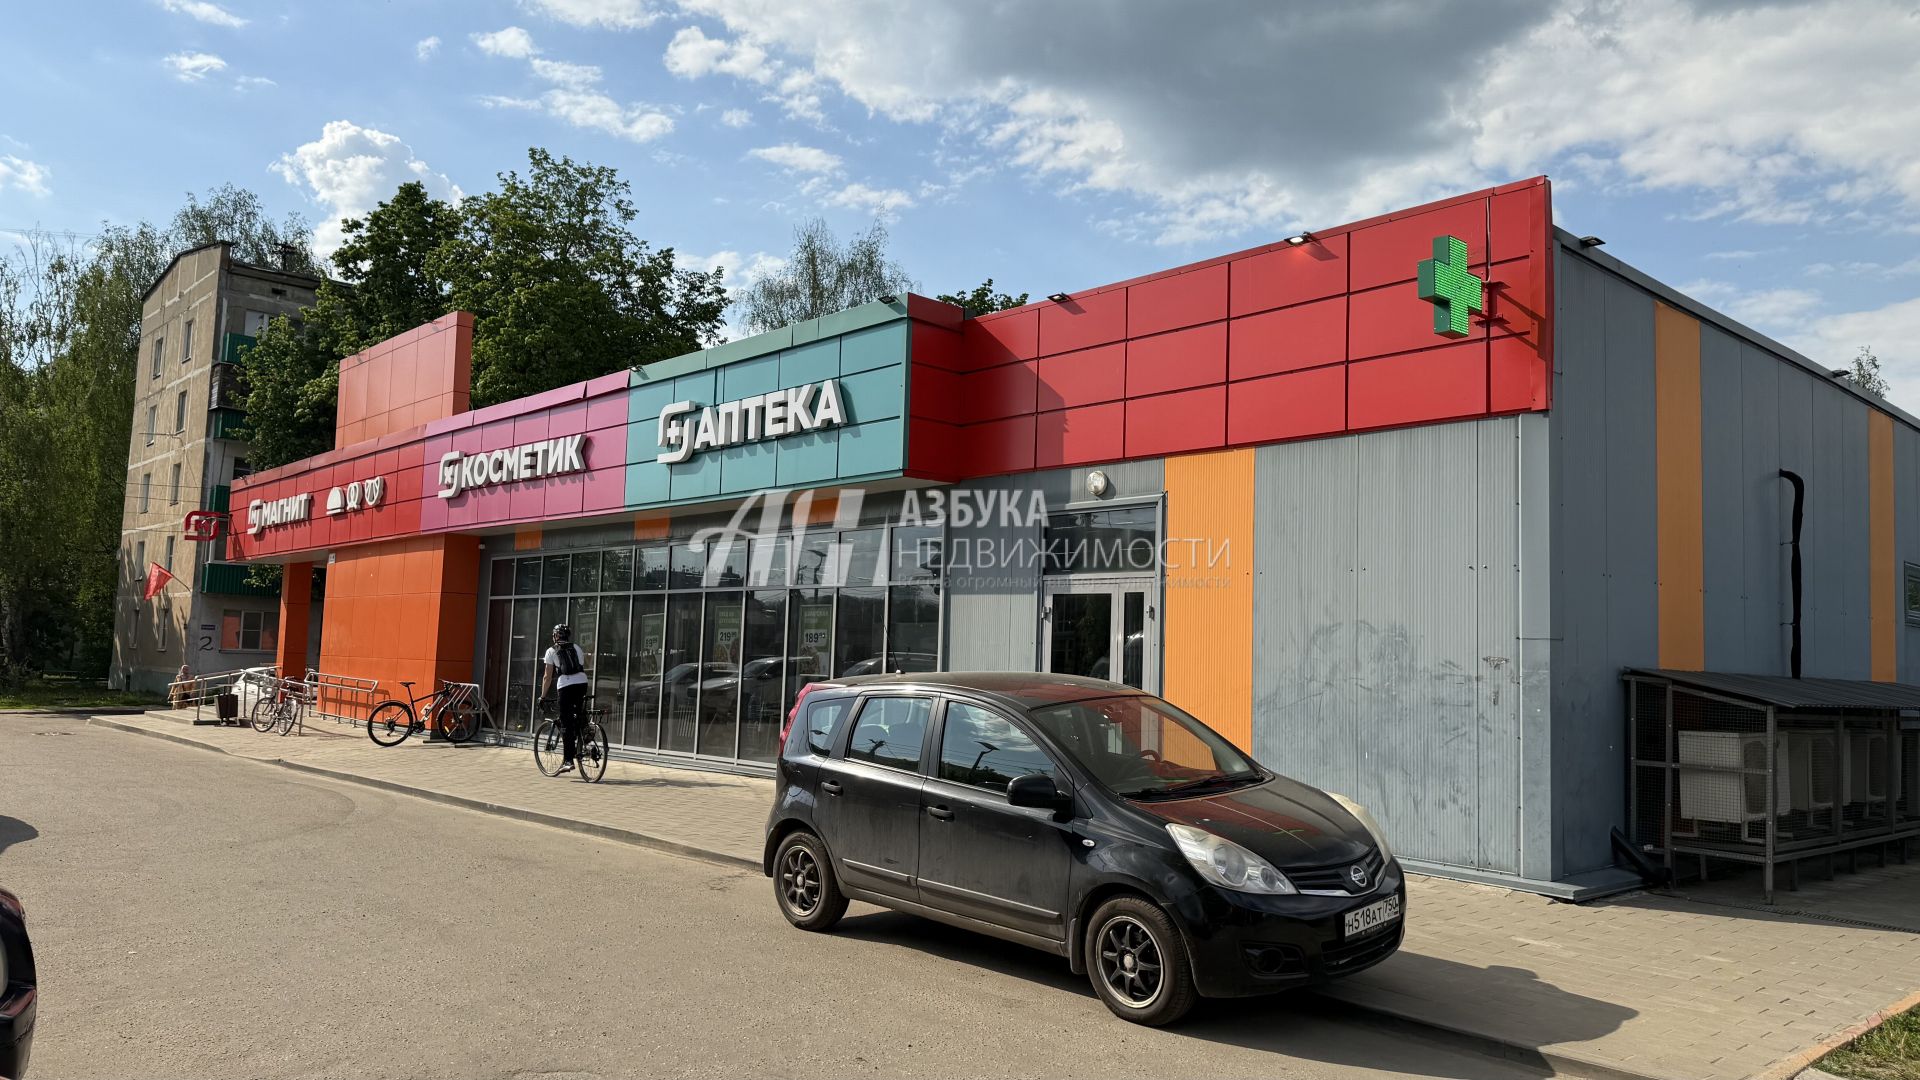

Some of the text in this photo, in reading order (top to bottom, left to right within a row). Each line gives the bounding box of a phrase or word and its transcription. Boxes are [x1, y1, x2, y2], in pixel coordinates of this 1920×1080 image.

[694, 379, 845, 449] АПТЕКА
[461, 434, 585, 488] КОСМЕТИК
[262, 493, 312, 527] МАГНИТ
[199, 636, 214, 652] 2
[804, 632, 819, 643] 189
